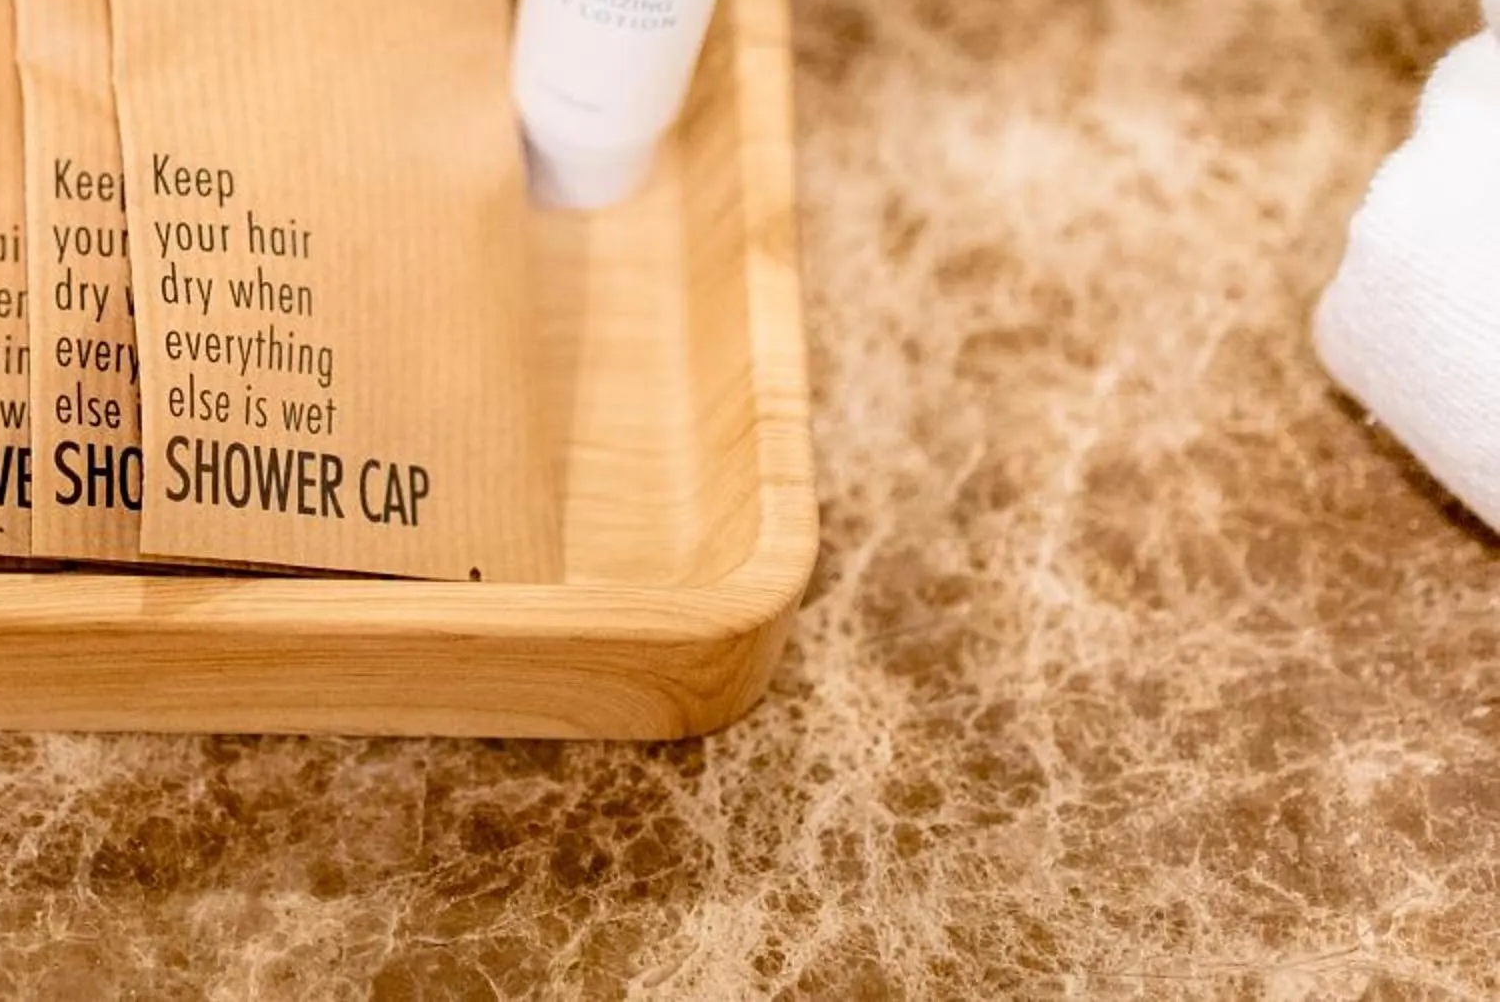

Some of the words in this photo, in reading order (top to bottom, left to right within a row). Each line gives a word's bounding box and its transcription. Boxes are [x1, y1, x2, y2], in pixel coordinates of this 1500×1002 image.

[152, 153, 234, 206] Keep
[53, 224, 128, 264] your
[154, 220, 229, 259] your
[247, 210, 312, 259] hair
[55, 267, 110, 322] dry
[161, 261, 213, 316] dry
[229, 266, 313, 317] when
[165, 324, 334, 388] everything
[55, 381, 121, 429] else
[168, 373, 230, 423] else
[244, 384, 268, 428] is
[282, 397, 337, 436] wet
[54, 439, 143, 511] SHO
[166, 434, 345, 519] SHOWER
[359, 458, 429, 527] CAP
